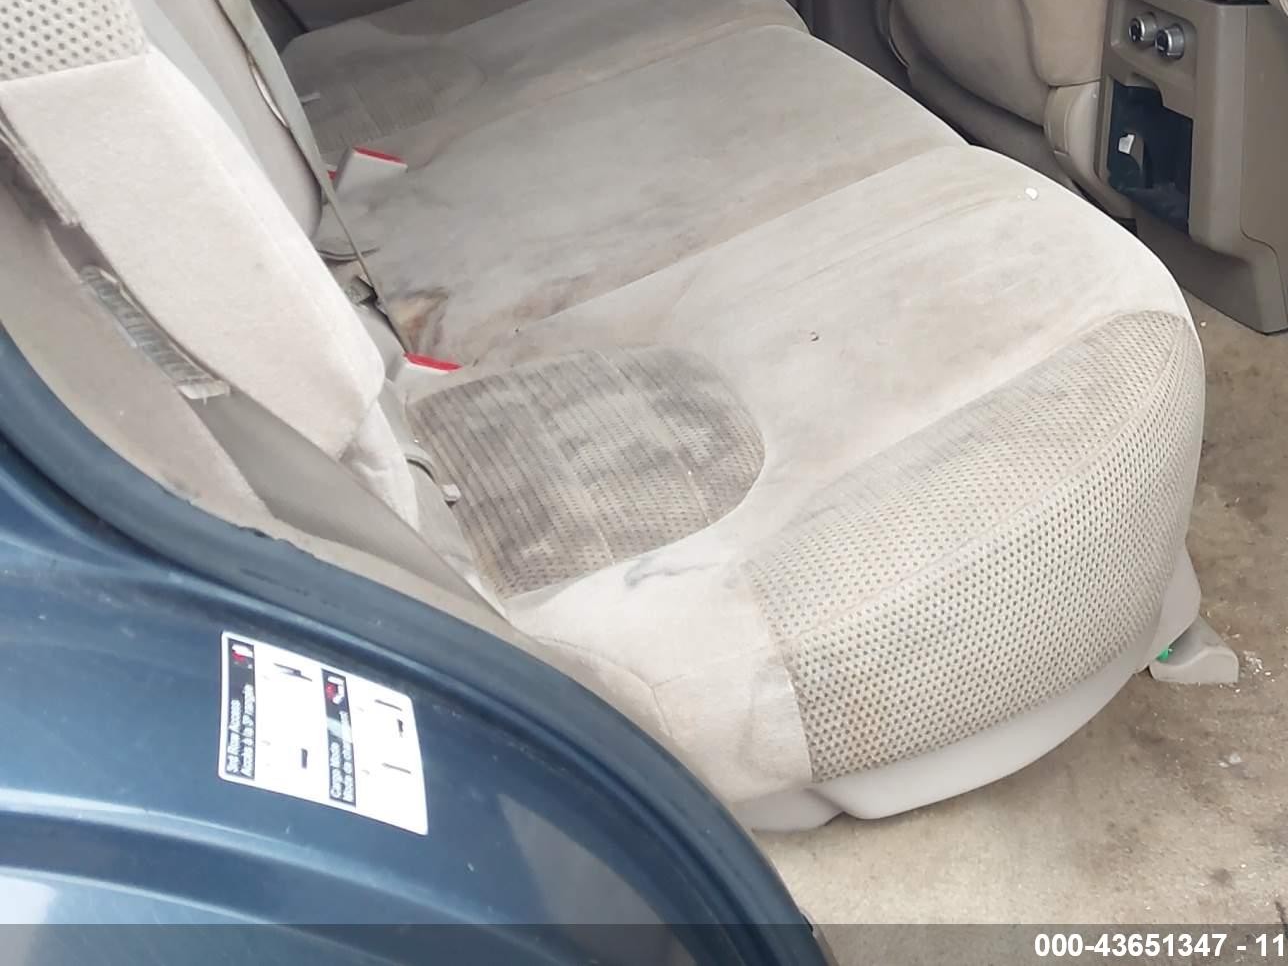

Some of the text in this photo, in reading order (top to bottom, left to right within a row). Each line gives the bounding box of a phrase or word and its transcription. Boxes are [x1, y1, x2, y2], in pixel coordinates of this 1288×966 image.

[226, 699, 240, 773] 3rd Row Access
[330, 742, 342, 798] Cargo Mode
[342, 775, 354, 802] Mode
[343, 762, 353, 774] de
